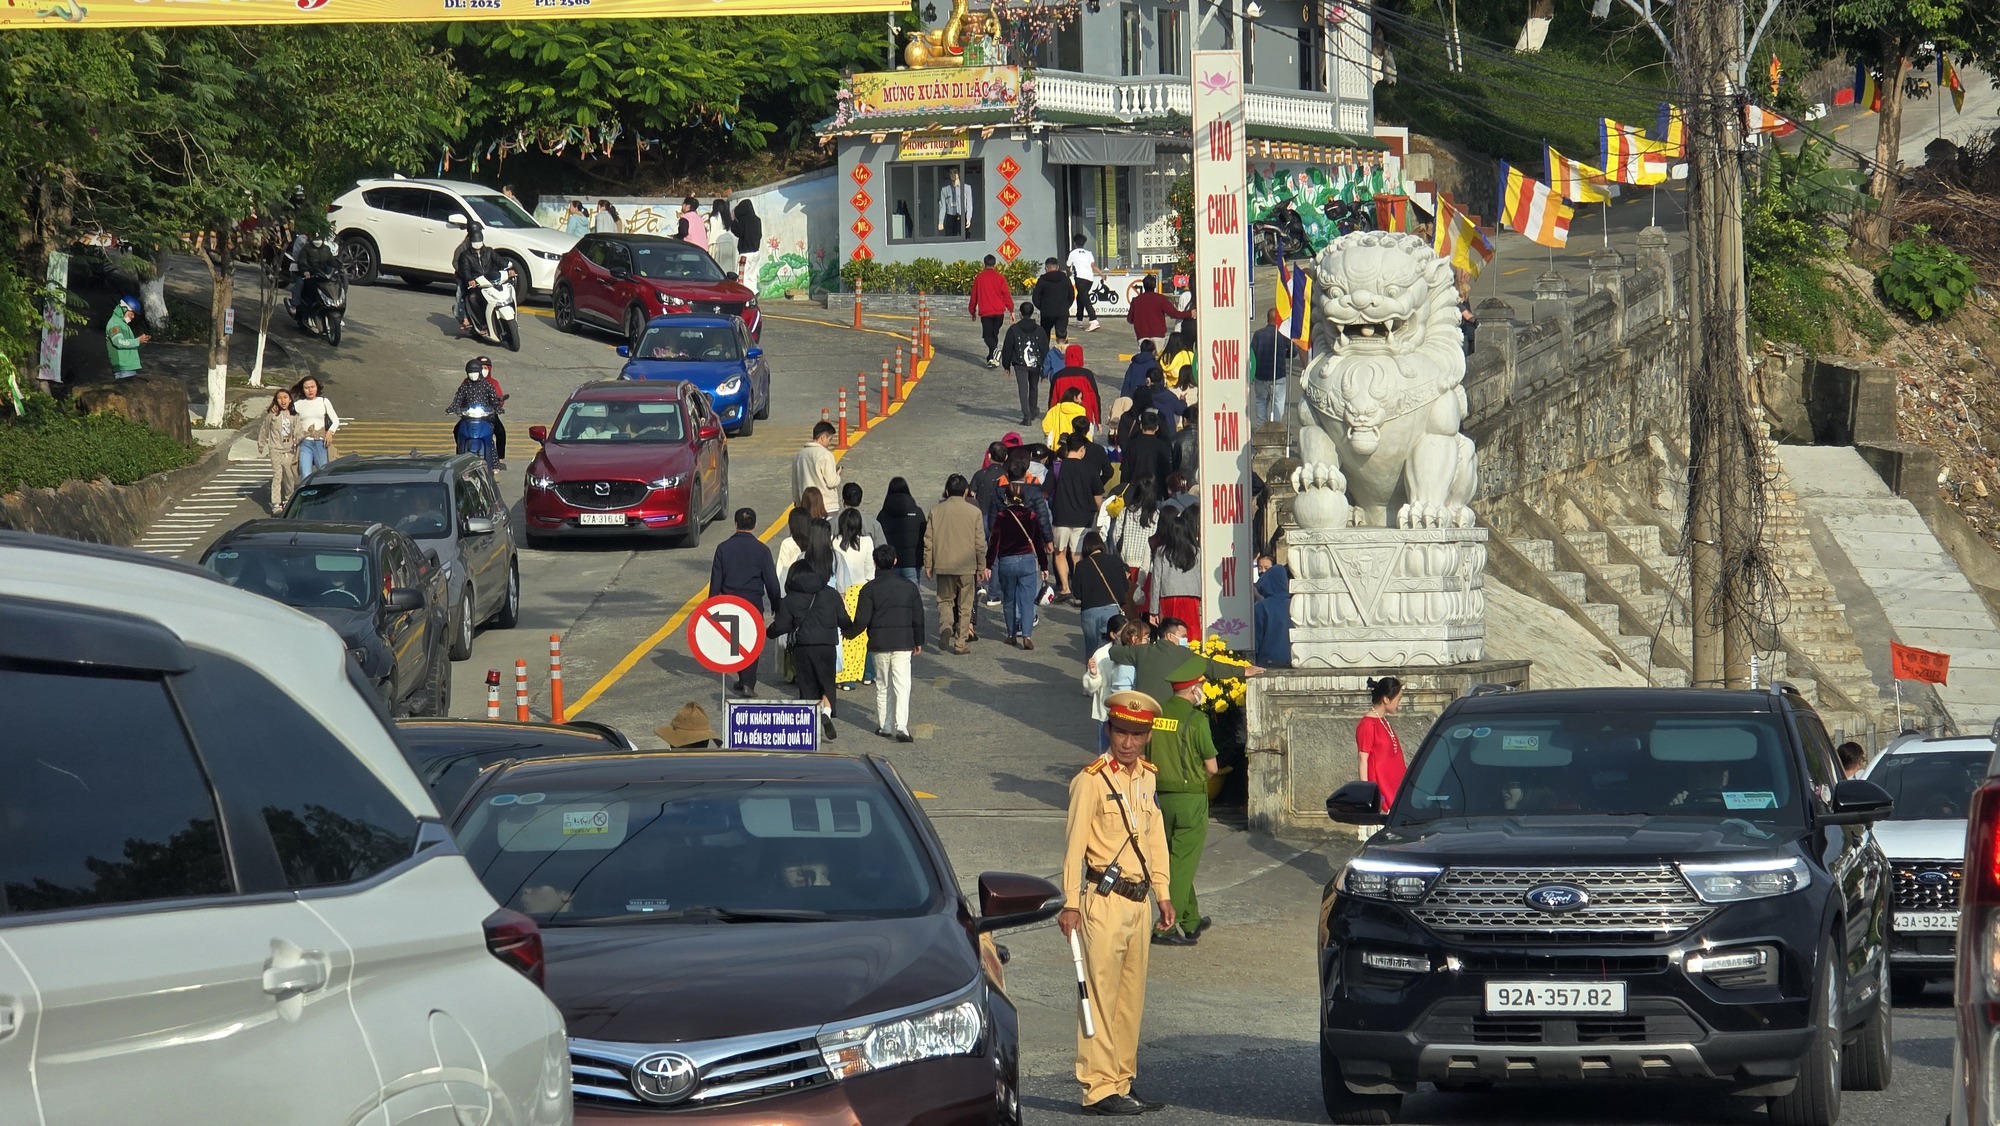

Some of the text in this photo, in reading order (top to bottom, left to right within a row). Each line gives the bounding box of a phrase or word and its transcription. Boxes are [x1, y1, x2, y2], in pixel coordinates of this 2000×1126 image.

[883, 83, 915, 103] MỪNG
[918, 79, 949, 101] XUÂN
[952, 83, 964, 99] DI
[1209, 112, 1232, 161] VÀO
[1207, 185, 1239, 235] CHÙA
[1213, 258, 1236, 308] HÃY
[1212, 339, 1240, 381] SINH
[1214, 403, 1239, 452] TÂM
[1212, 483, 1244, 525] HOAN
[1222, 542, 1237, 598] HỶ
[733, 728, 812, 747] TỪ 4 ĐẾN 52 CHỖ QUÁ TẢI
[735, 710, 749, 726] QUÝ
[749, 710, 771, 726] KHÁCH
[772, 710, 795, 726] THÔNG
[1154, 719, 1177, 730] CS 113
[1540, 890, 1572, 904] Ford
[1498, 988, 1612, 1006] 92A-357.82
